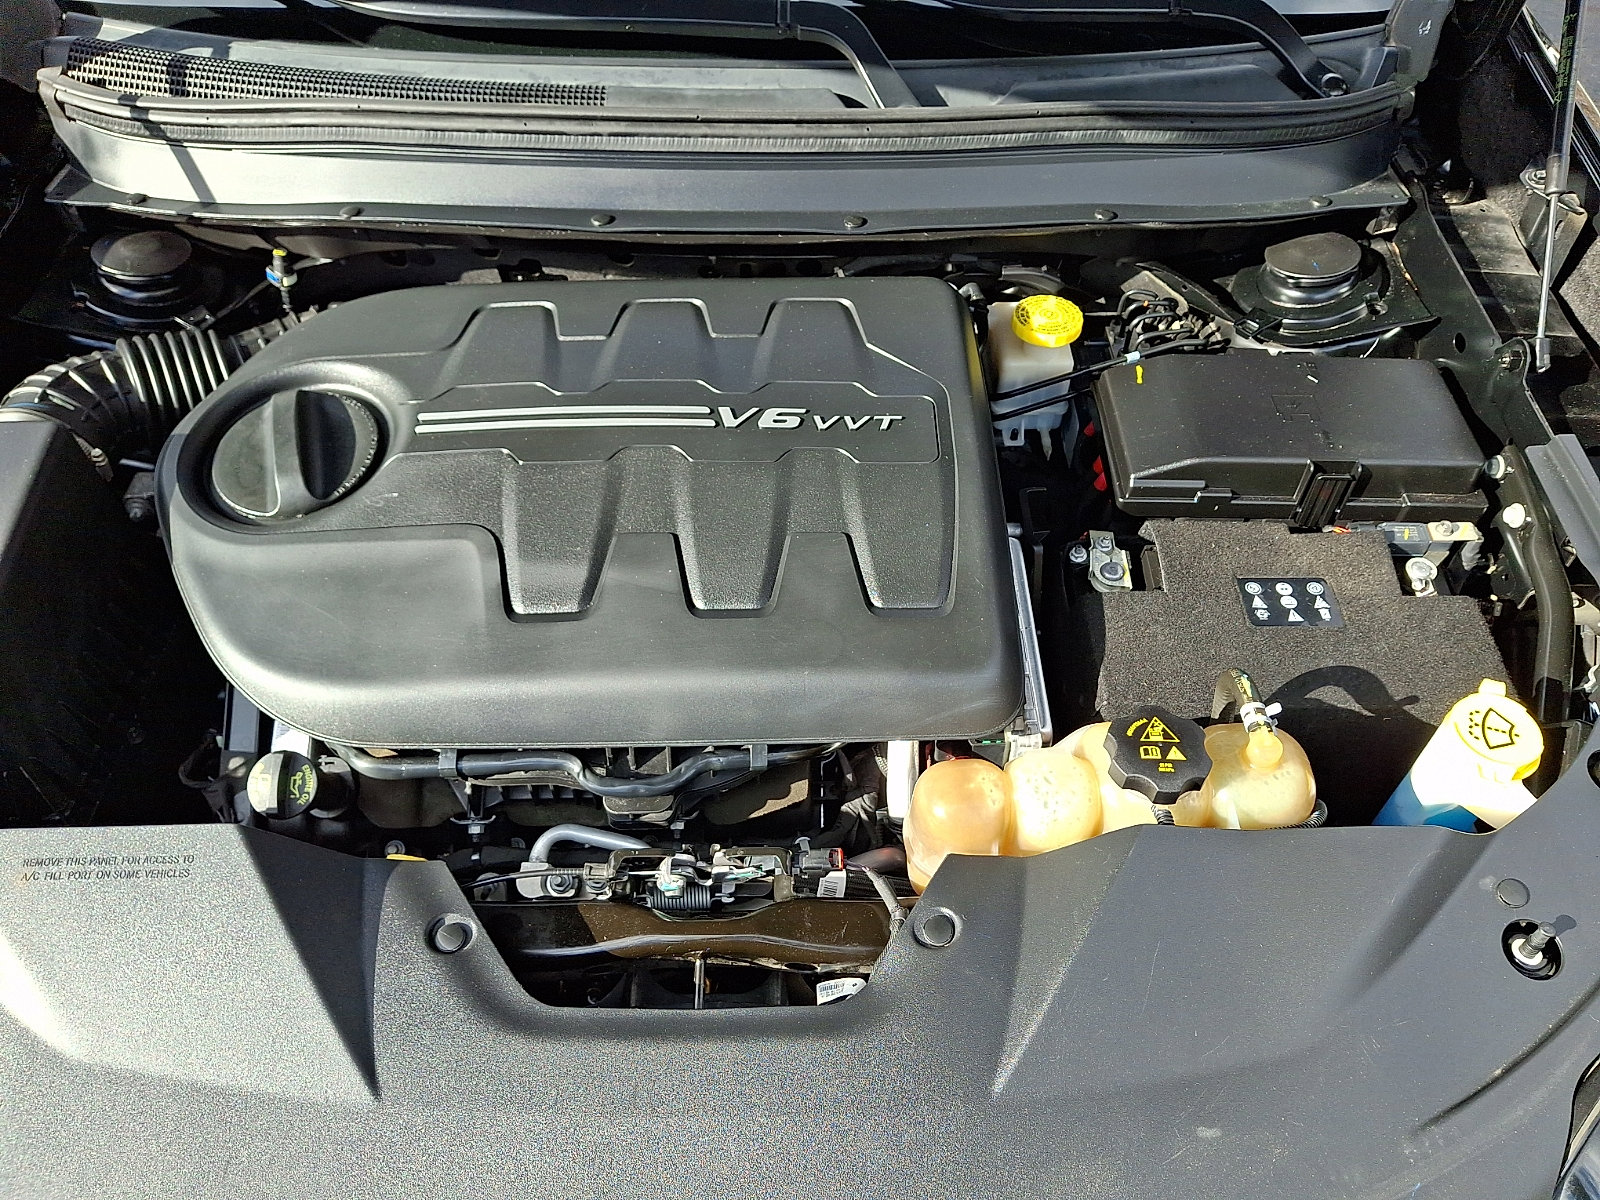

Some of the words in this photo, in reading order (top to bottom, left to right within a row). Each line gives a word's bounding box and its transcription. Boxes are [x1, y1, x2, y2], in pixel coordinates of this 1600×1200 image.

[717, 406, 808, 430] V6
[813, 415, 904, 432] VVT
[301, 764, 313, 792] ENGINE
[297, 793, 309, 805] OIL
[22, 857, 63, 867] REMOVE
[65, 856, 87, 866] THIS
[121, 856, 141, 865] FOR
[143, 855, 180, 865] ACCESS
[183, 854, 195, 864] TO
[20, 870, 41, 881] A/C
[44, 871, 63, 881] FILL
[67, 870, 92, 880] PORT
[96, 869, 111, 880] ON
[112, 869, 142, 879] SOME
[144, 868, 191, 879] VEHICLES
